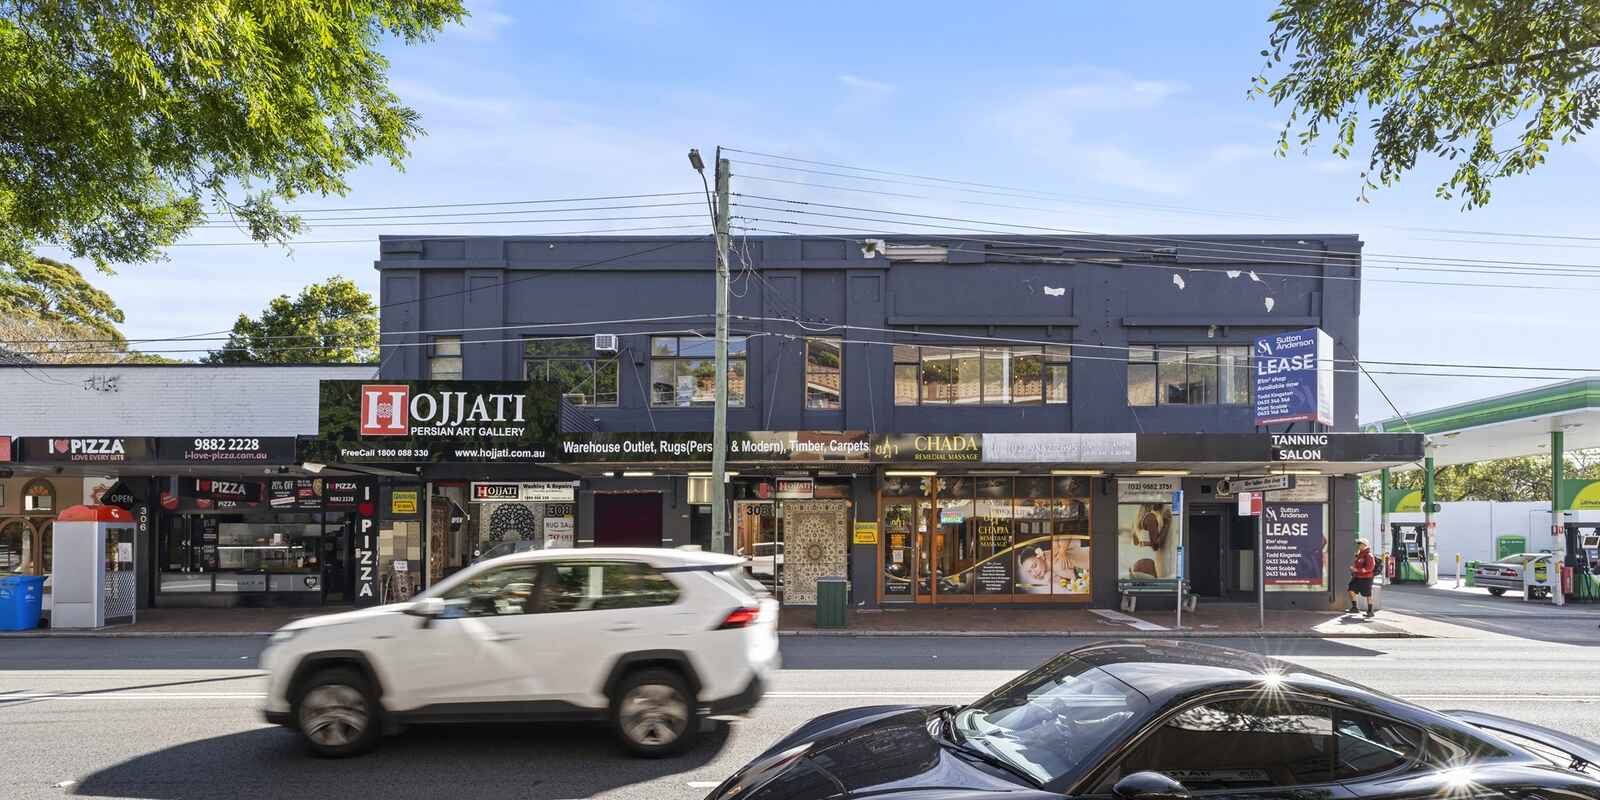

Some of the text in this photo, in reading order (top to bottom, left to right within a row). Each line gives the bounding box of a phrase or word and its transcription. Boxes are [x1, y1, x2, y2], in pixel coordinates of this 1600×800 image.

[1276, 335, 1302, 344] Sutton
[1276, 339, 1314, 350] Anderson
[1257, 353, 1315, 376] LEASE
[1257, 383, 1285, 391] Available
[364, 391, 527, 430] HOJJATI
[411, 426, 525, 436] PERSIAN ART GALLERY
[49, 438, 125, 454] I PIZZA
[194, 438, 260, 451] 9882 2228
[914, 435, 978, 451] CHADA
[1272, 434, 1328, 446] TANNING
[341, 449, 429, 457] FreeCall 1800 088 330
[563, 440, 620, 454] Warehouse
[623, 440, 657, 455] Outlet,
[731, 440, 739, 452] &
[741, 439, 786, 455] Modern),
[789, 439, 826, 454] Timber,
[829, 439, 869, 454] Carpets
[184, 450, 268, 461] i-love-pizza.com.au
[455, 448, 545, 460] www.hojjati.com.au
[1279, 449, 1321, 460] SALON
[211, 480, 247, 496] PIZZA
[335, 482, 357, 490] PIZZA
[476, 485, 517, 498] HOJJATI
[111, 494, 133, 503] OPEN
[549, 505, 570, 515] 308
[139, 506, 147, 531] 306
[978, 526, 1009, 534] CHADA
[1266, 523, 1309, 536] LEASE
[360, 486, 373, 597] I PIZZA
